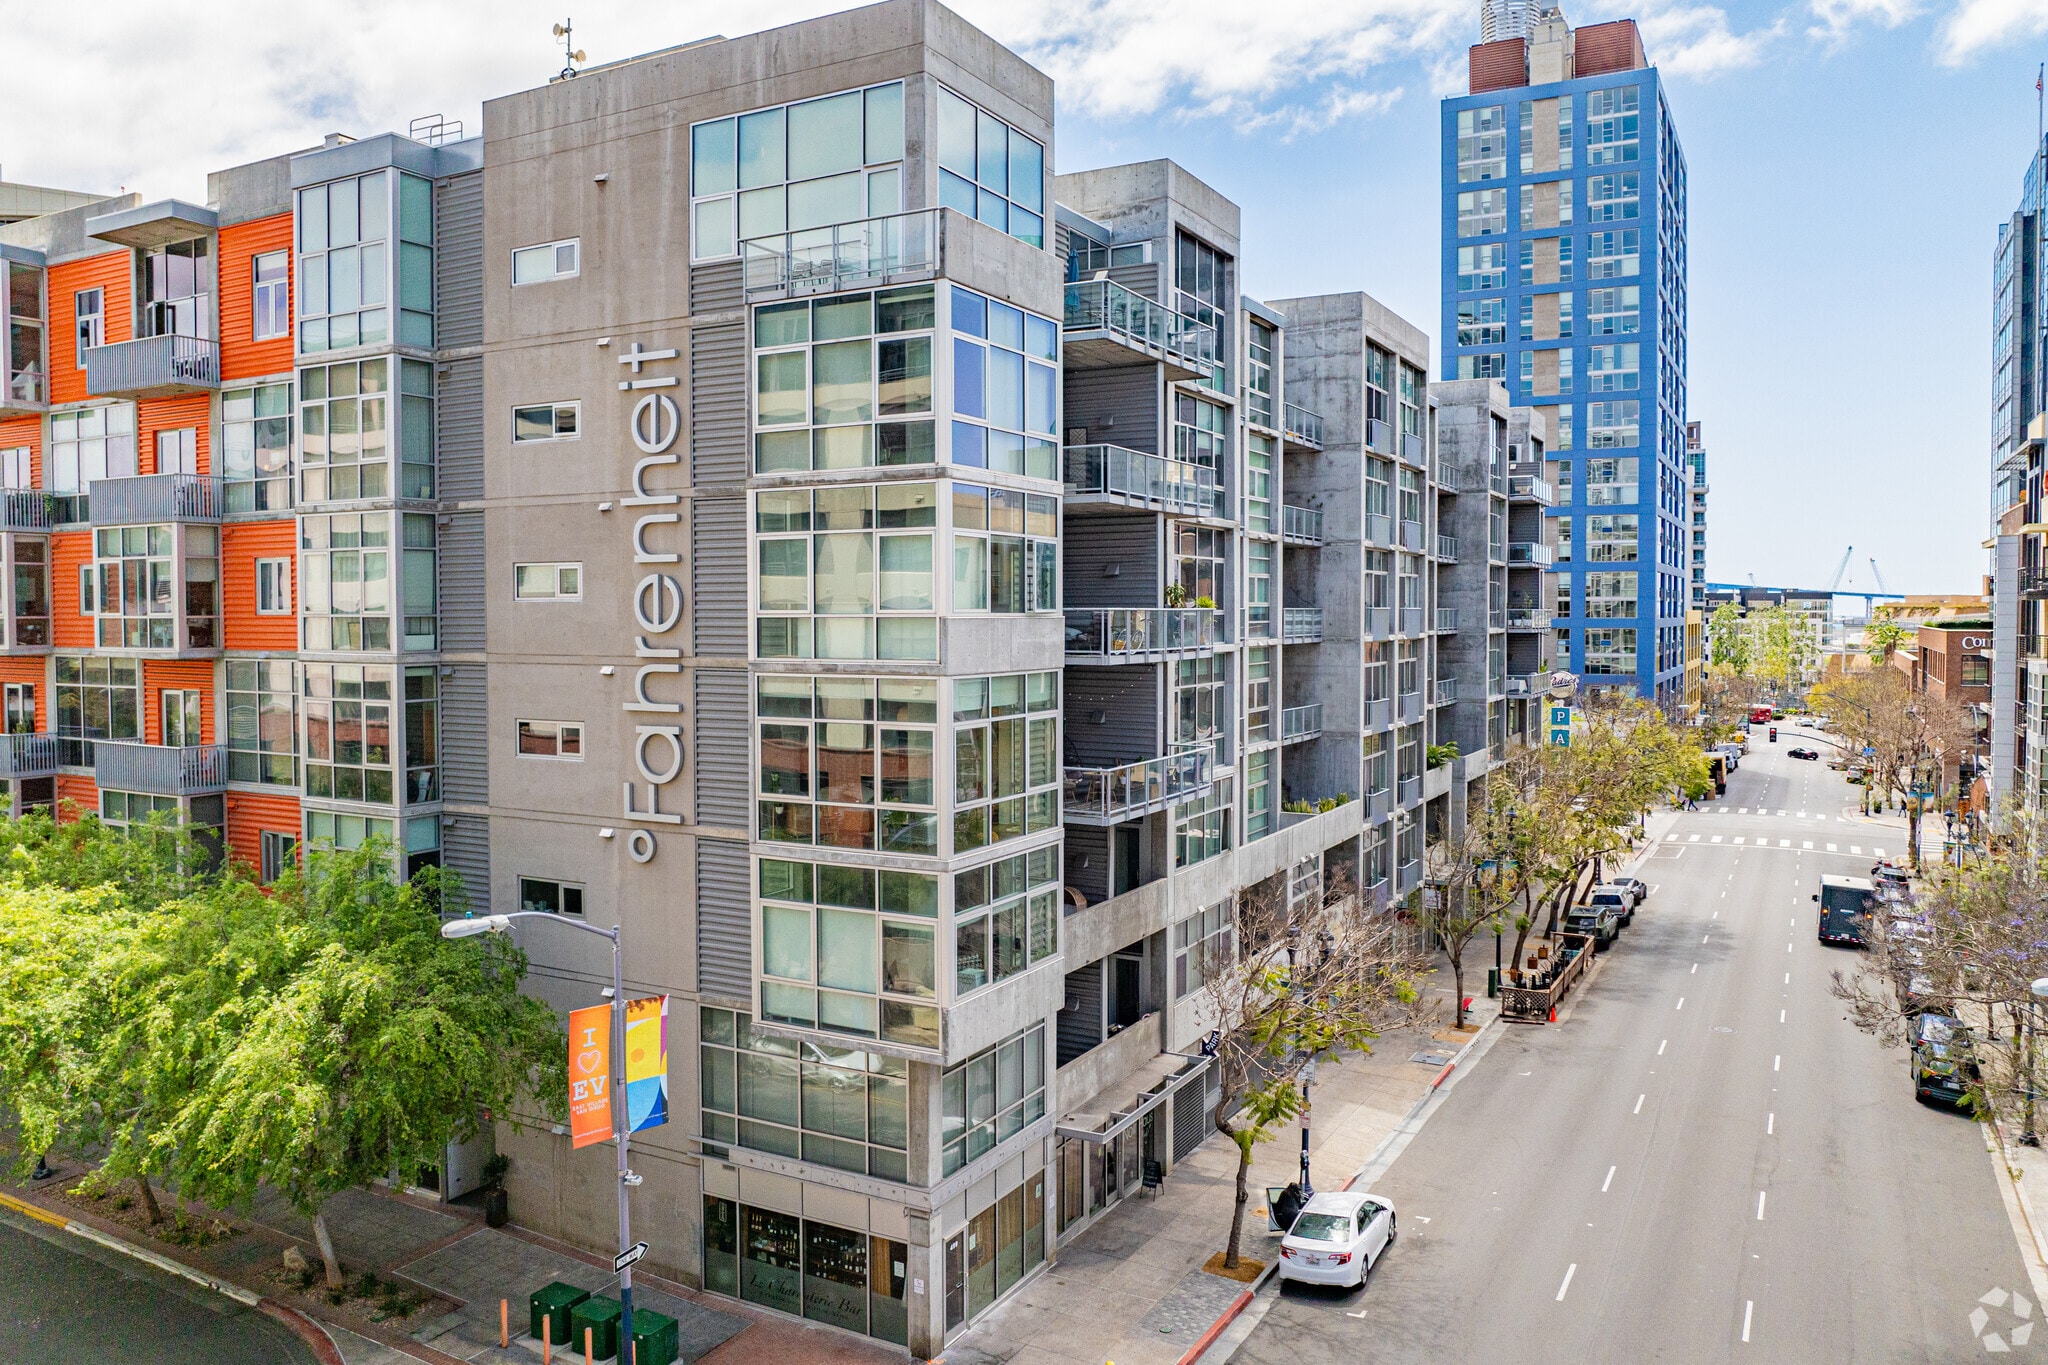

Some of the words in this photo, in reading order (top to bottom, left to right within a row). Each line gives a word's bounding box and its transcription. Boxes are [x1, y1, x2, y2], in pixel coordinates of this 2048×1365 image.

[583, 1027, 596, 1048] I
[1205, 1032, 1220, 1052] PARK
[572, 1075, 607, 1101] EV
[572, 1103, 585, 1112] EAST
[587, 1097, 609, 1107] VILLAGE
[576, 1108, 588, 1116] SAN
[588, 1103, 606, 1112] DIEGO
[618, 1256, 629, 1267] ONE
[629, 1251, 638, 1260] WAY
[839, 1297, 864, 1315] Bar
